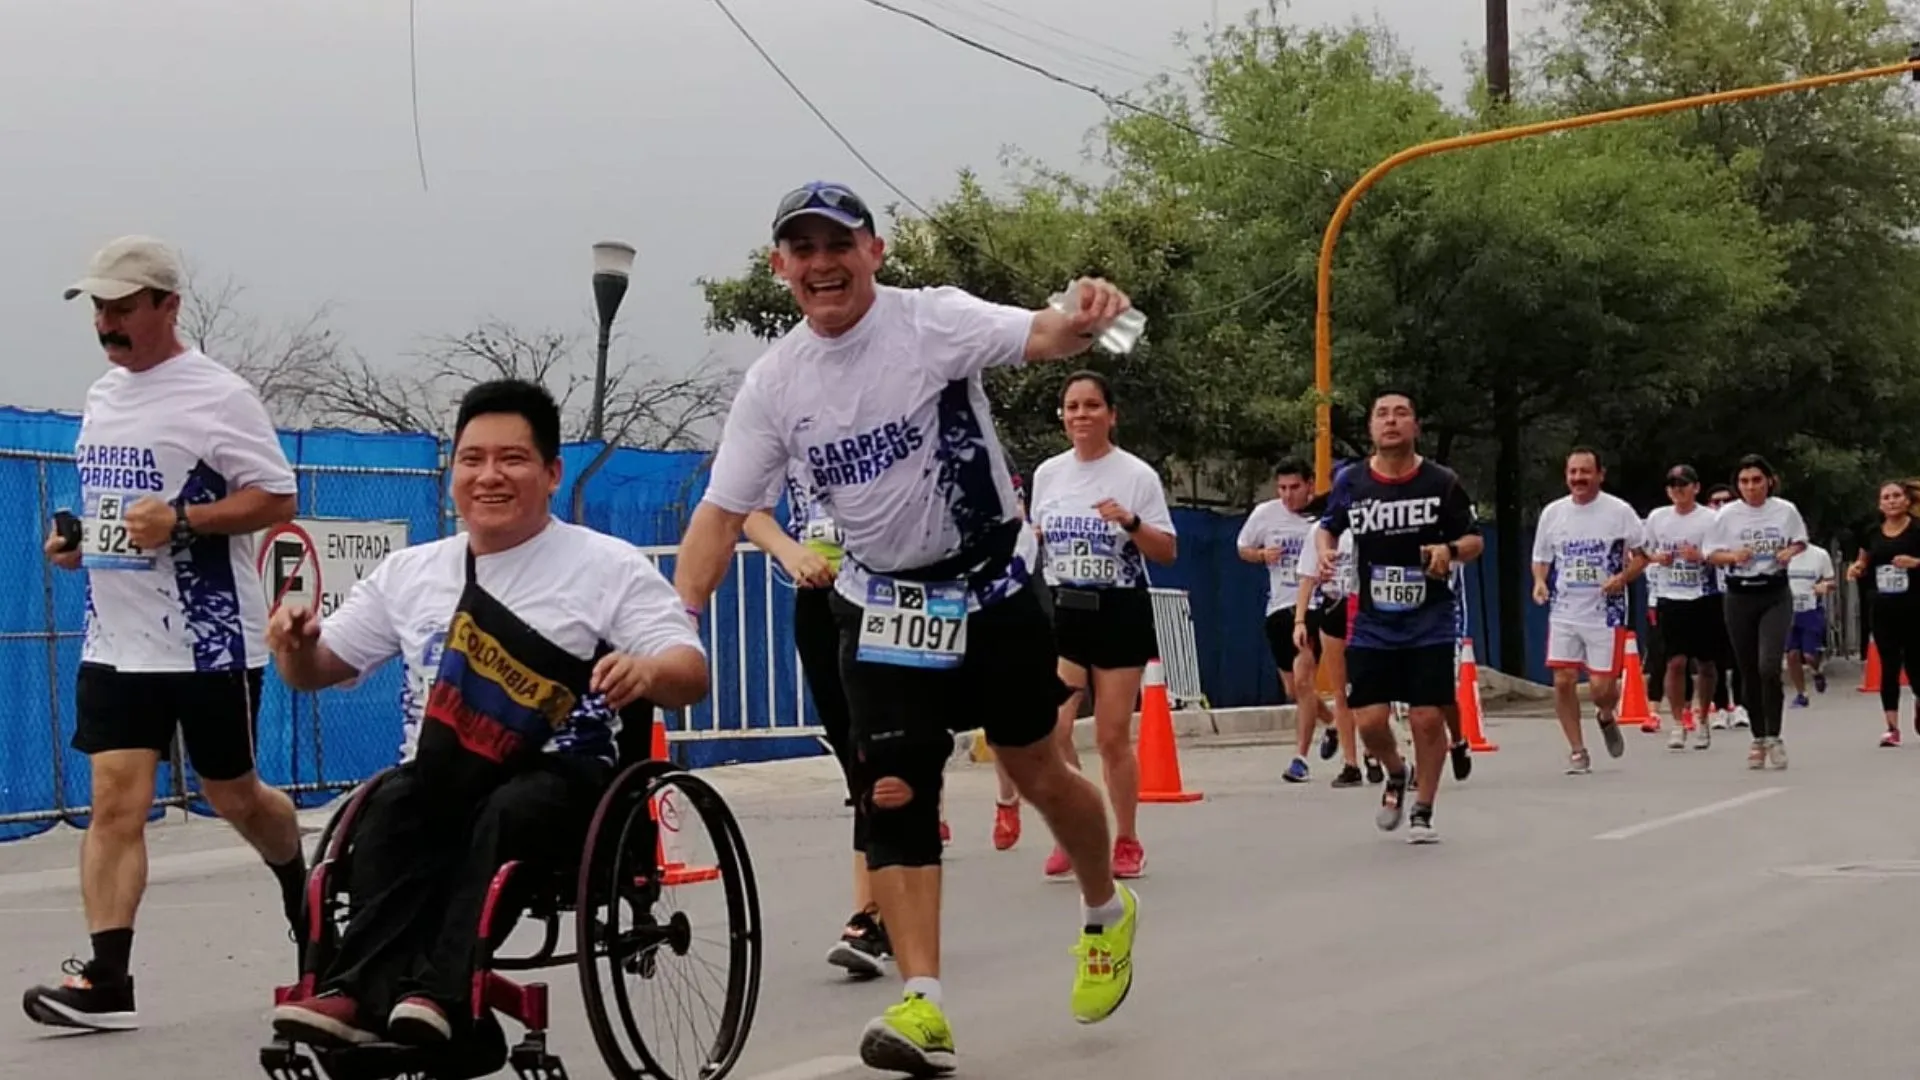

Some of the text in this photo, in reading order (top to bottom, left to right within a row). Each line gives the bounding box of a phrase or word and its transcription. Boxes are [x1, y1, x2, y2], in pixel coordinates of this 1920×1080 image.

[80, 466, 165, 492] ORREGOS
[1347, 496, 1441, 535] EXATEC
[327, 533, 391, 560] ENTRADA
[1070, 559, 1115, 578] 1636
[1385, 585, 1424, 604] 1667
[890, 613, 962, 651] 1097
[458, 622, 541, 701] COLOMBIA
